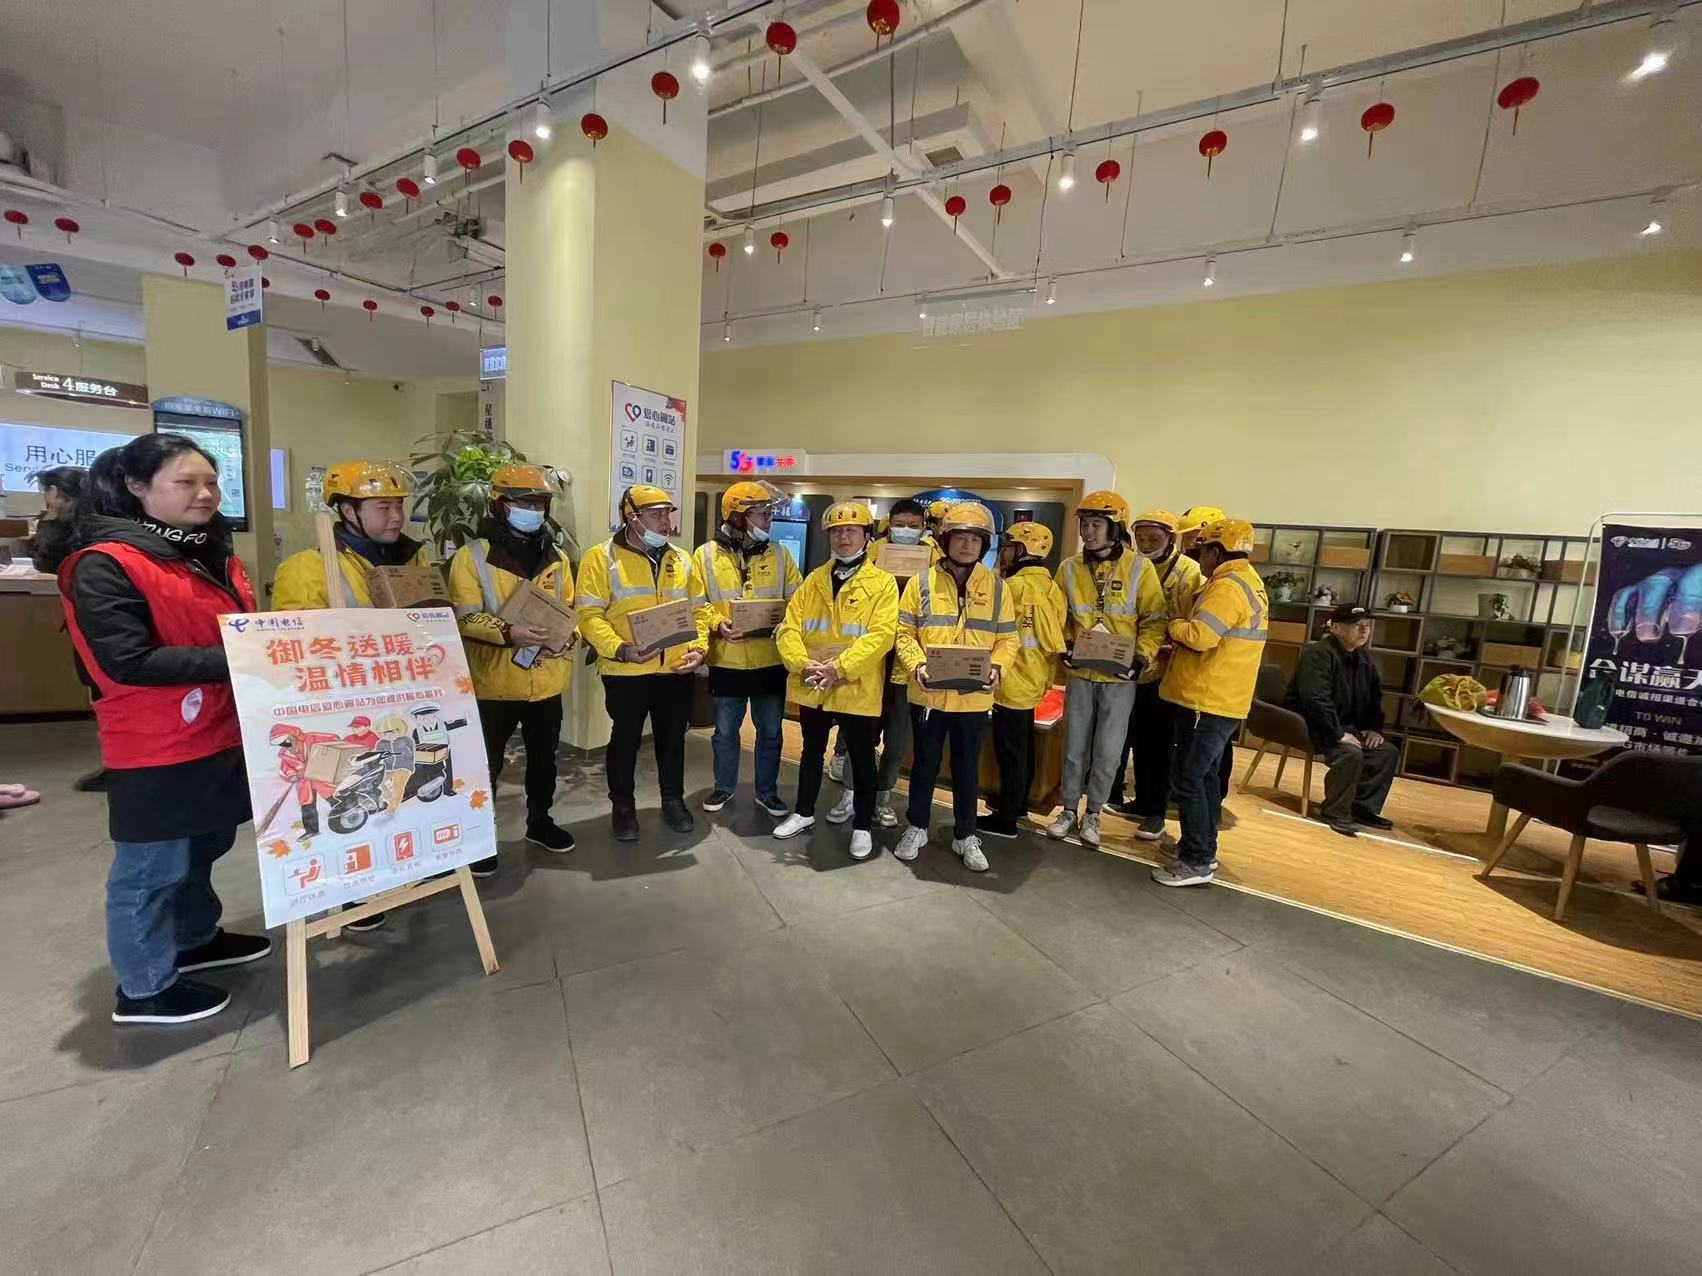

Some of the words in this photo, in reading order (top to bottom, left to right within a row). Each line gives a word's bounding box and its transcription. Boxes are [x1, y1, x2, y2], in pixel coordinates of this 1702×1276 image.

[32, 373, 60, 382] Service
[40, 381, 60, 390] Desk
[729, 450, 754, 473] 5G
[255, 616, 303, 629] 中国电信
[265, 631, 415, 666] 御冬送暖
[294, 657, 436, 693] 温情相伴
[1615, 688, 1702, 708] 电信诚招渠道合
[1633, 711, 1652, 722] TO
[1655, 714, 1682, 726] WIN
